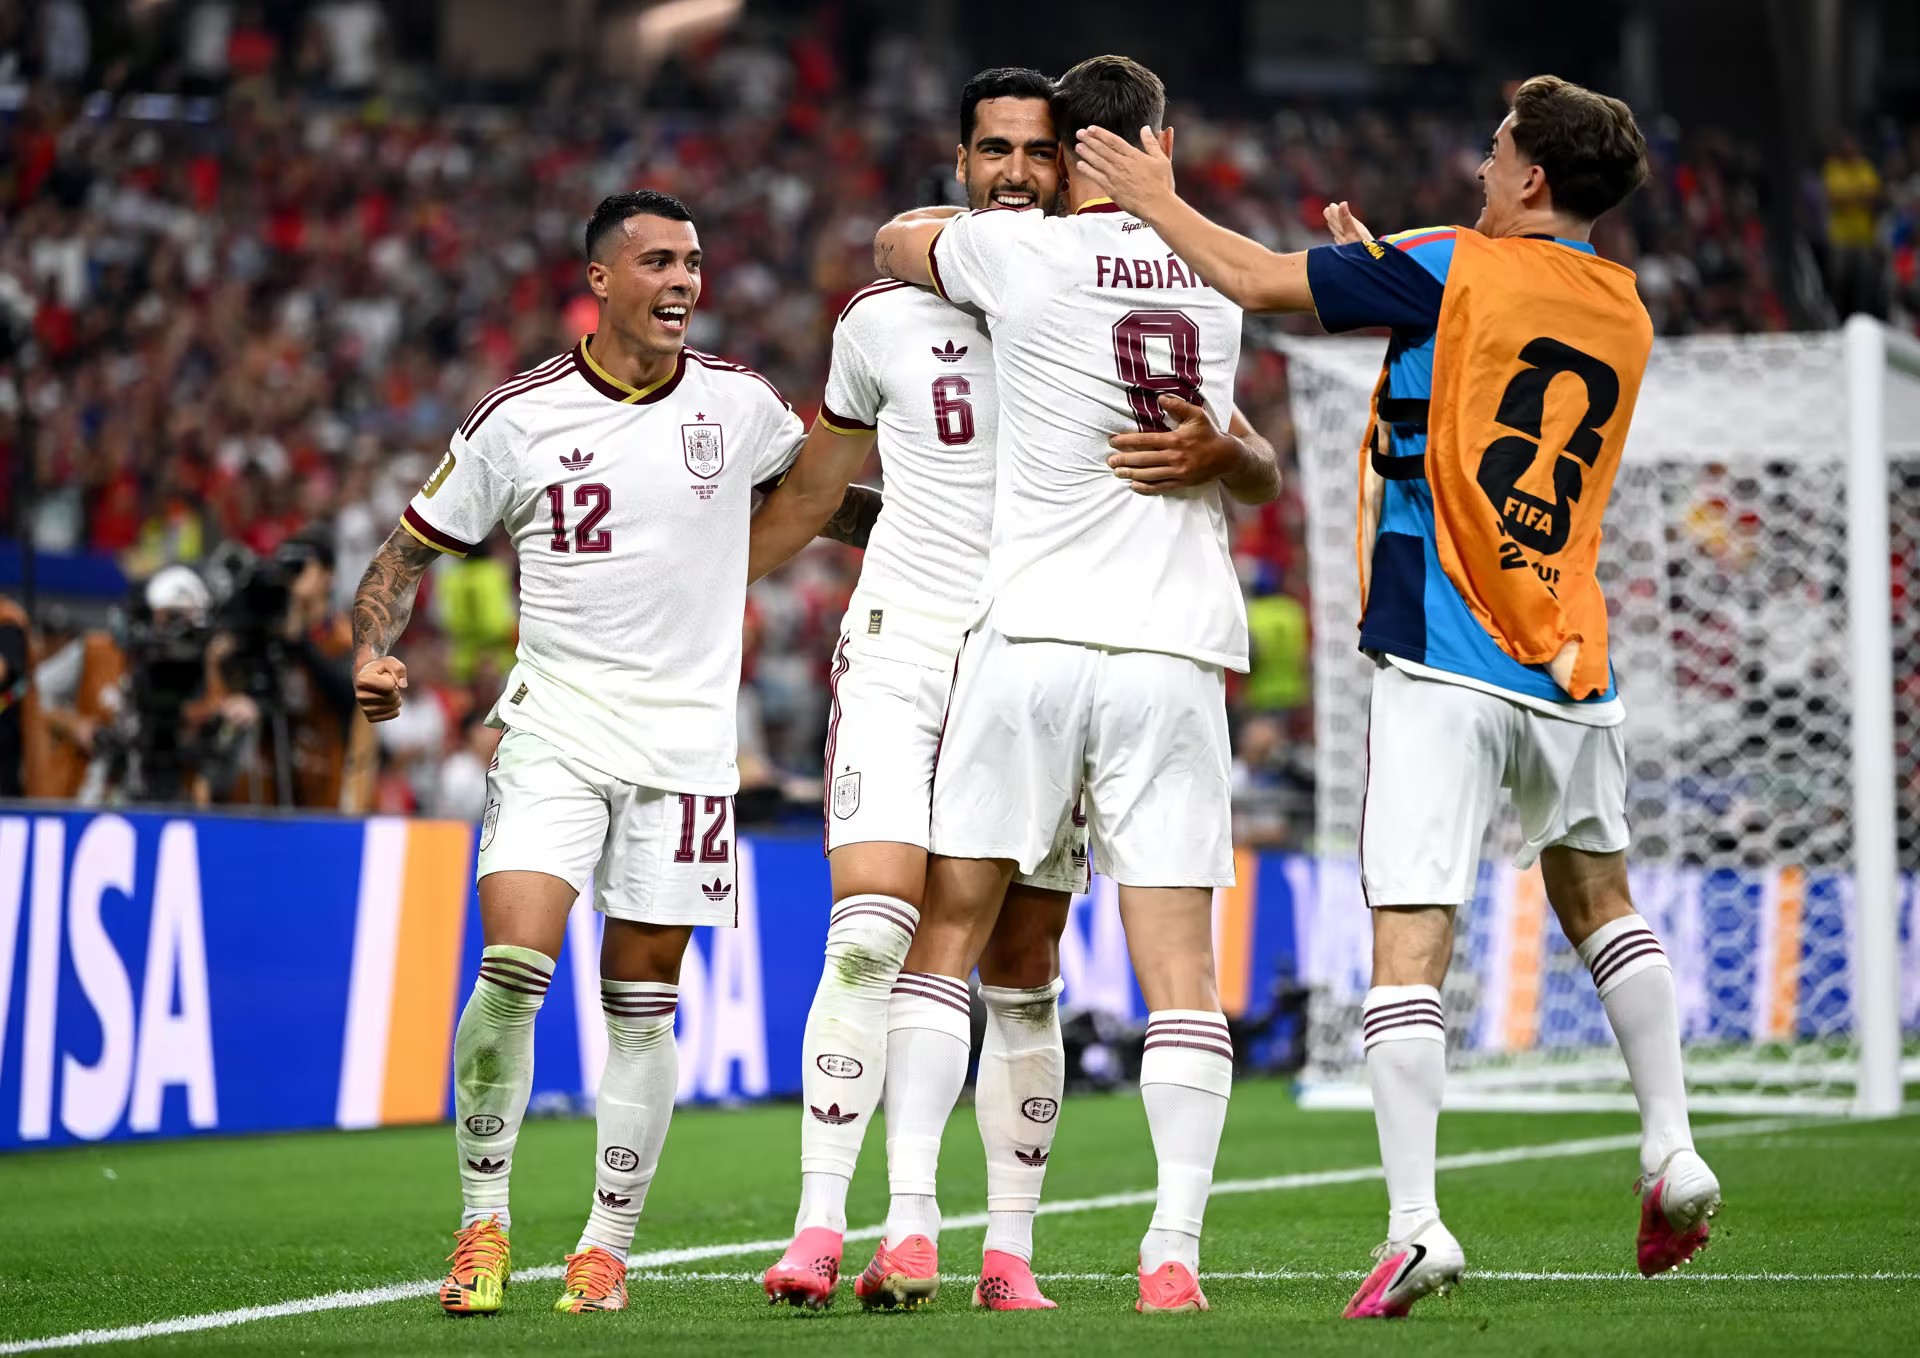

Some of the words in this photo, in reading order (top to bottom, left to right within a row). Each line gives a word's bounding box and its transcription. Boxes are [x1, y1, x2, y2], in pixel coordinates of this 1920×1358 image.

[931, 375, 976, 447] 6
[547, 482, 612, 554] 12
[1502, 496, 1553, 537] FIFA
[673, 794, 729, 864] 12
